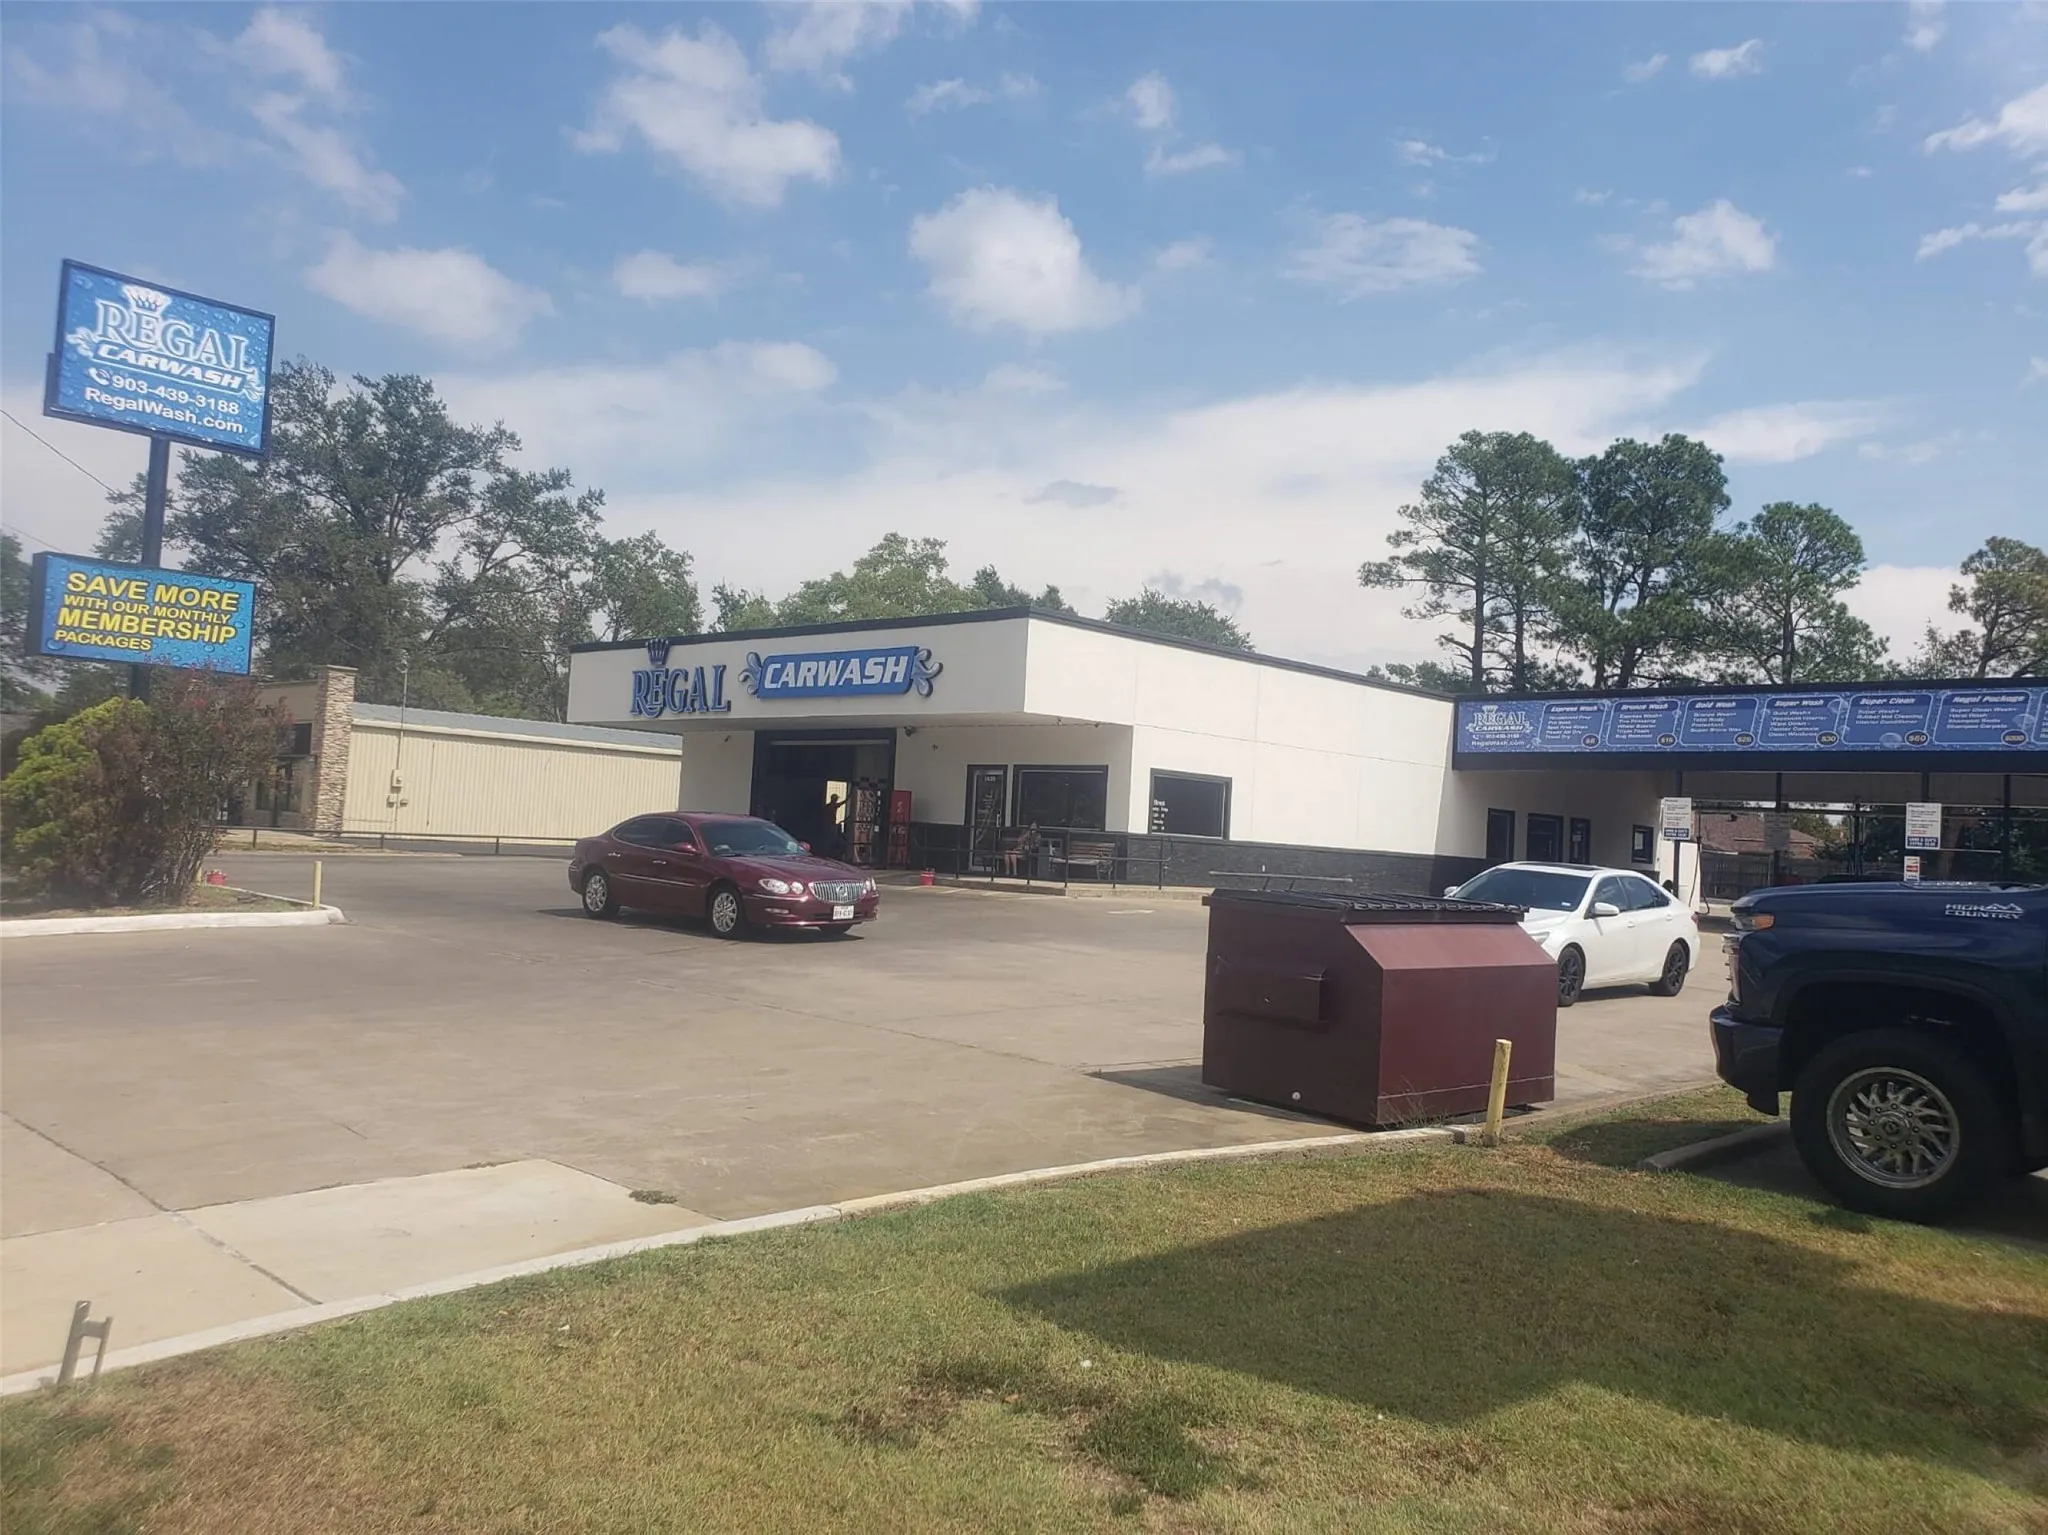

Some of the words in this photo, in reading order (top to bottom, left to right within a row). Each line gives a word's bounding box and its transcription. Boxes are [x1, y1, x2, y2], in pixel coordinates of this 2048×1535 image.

[95, 297, 257, 372] REGAL
[98, 344, 243, 389] CARWASH
[85, 387, 243, 434] RegalWash.com
[111, 375, 239, 415] 903-439-3188
[64, 594, 108, 610] WITH
[111, 601, 150, 615] OUR
[153, 606, 231, 624] MONTHLY
[67, 572, 149, 600] SAVE
[154, 584, 240, 611] MORE
[54, 630, 151, 650] PACKAGES
[57, 607, 237, 644] MEMBERSHIP
[629, 664, 731, 718] REGAL
[764, 656, 908, 690] CARWASH
[1952, 695, 1981, 704] Regal
[1982, 695, 2026, 703] Package
[1473, 711, 1526, 726] REGAL
[1944, 910, 2021, 919] COUNTRY
